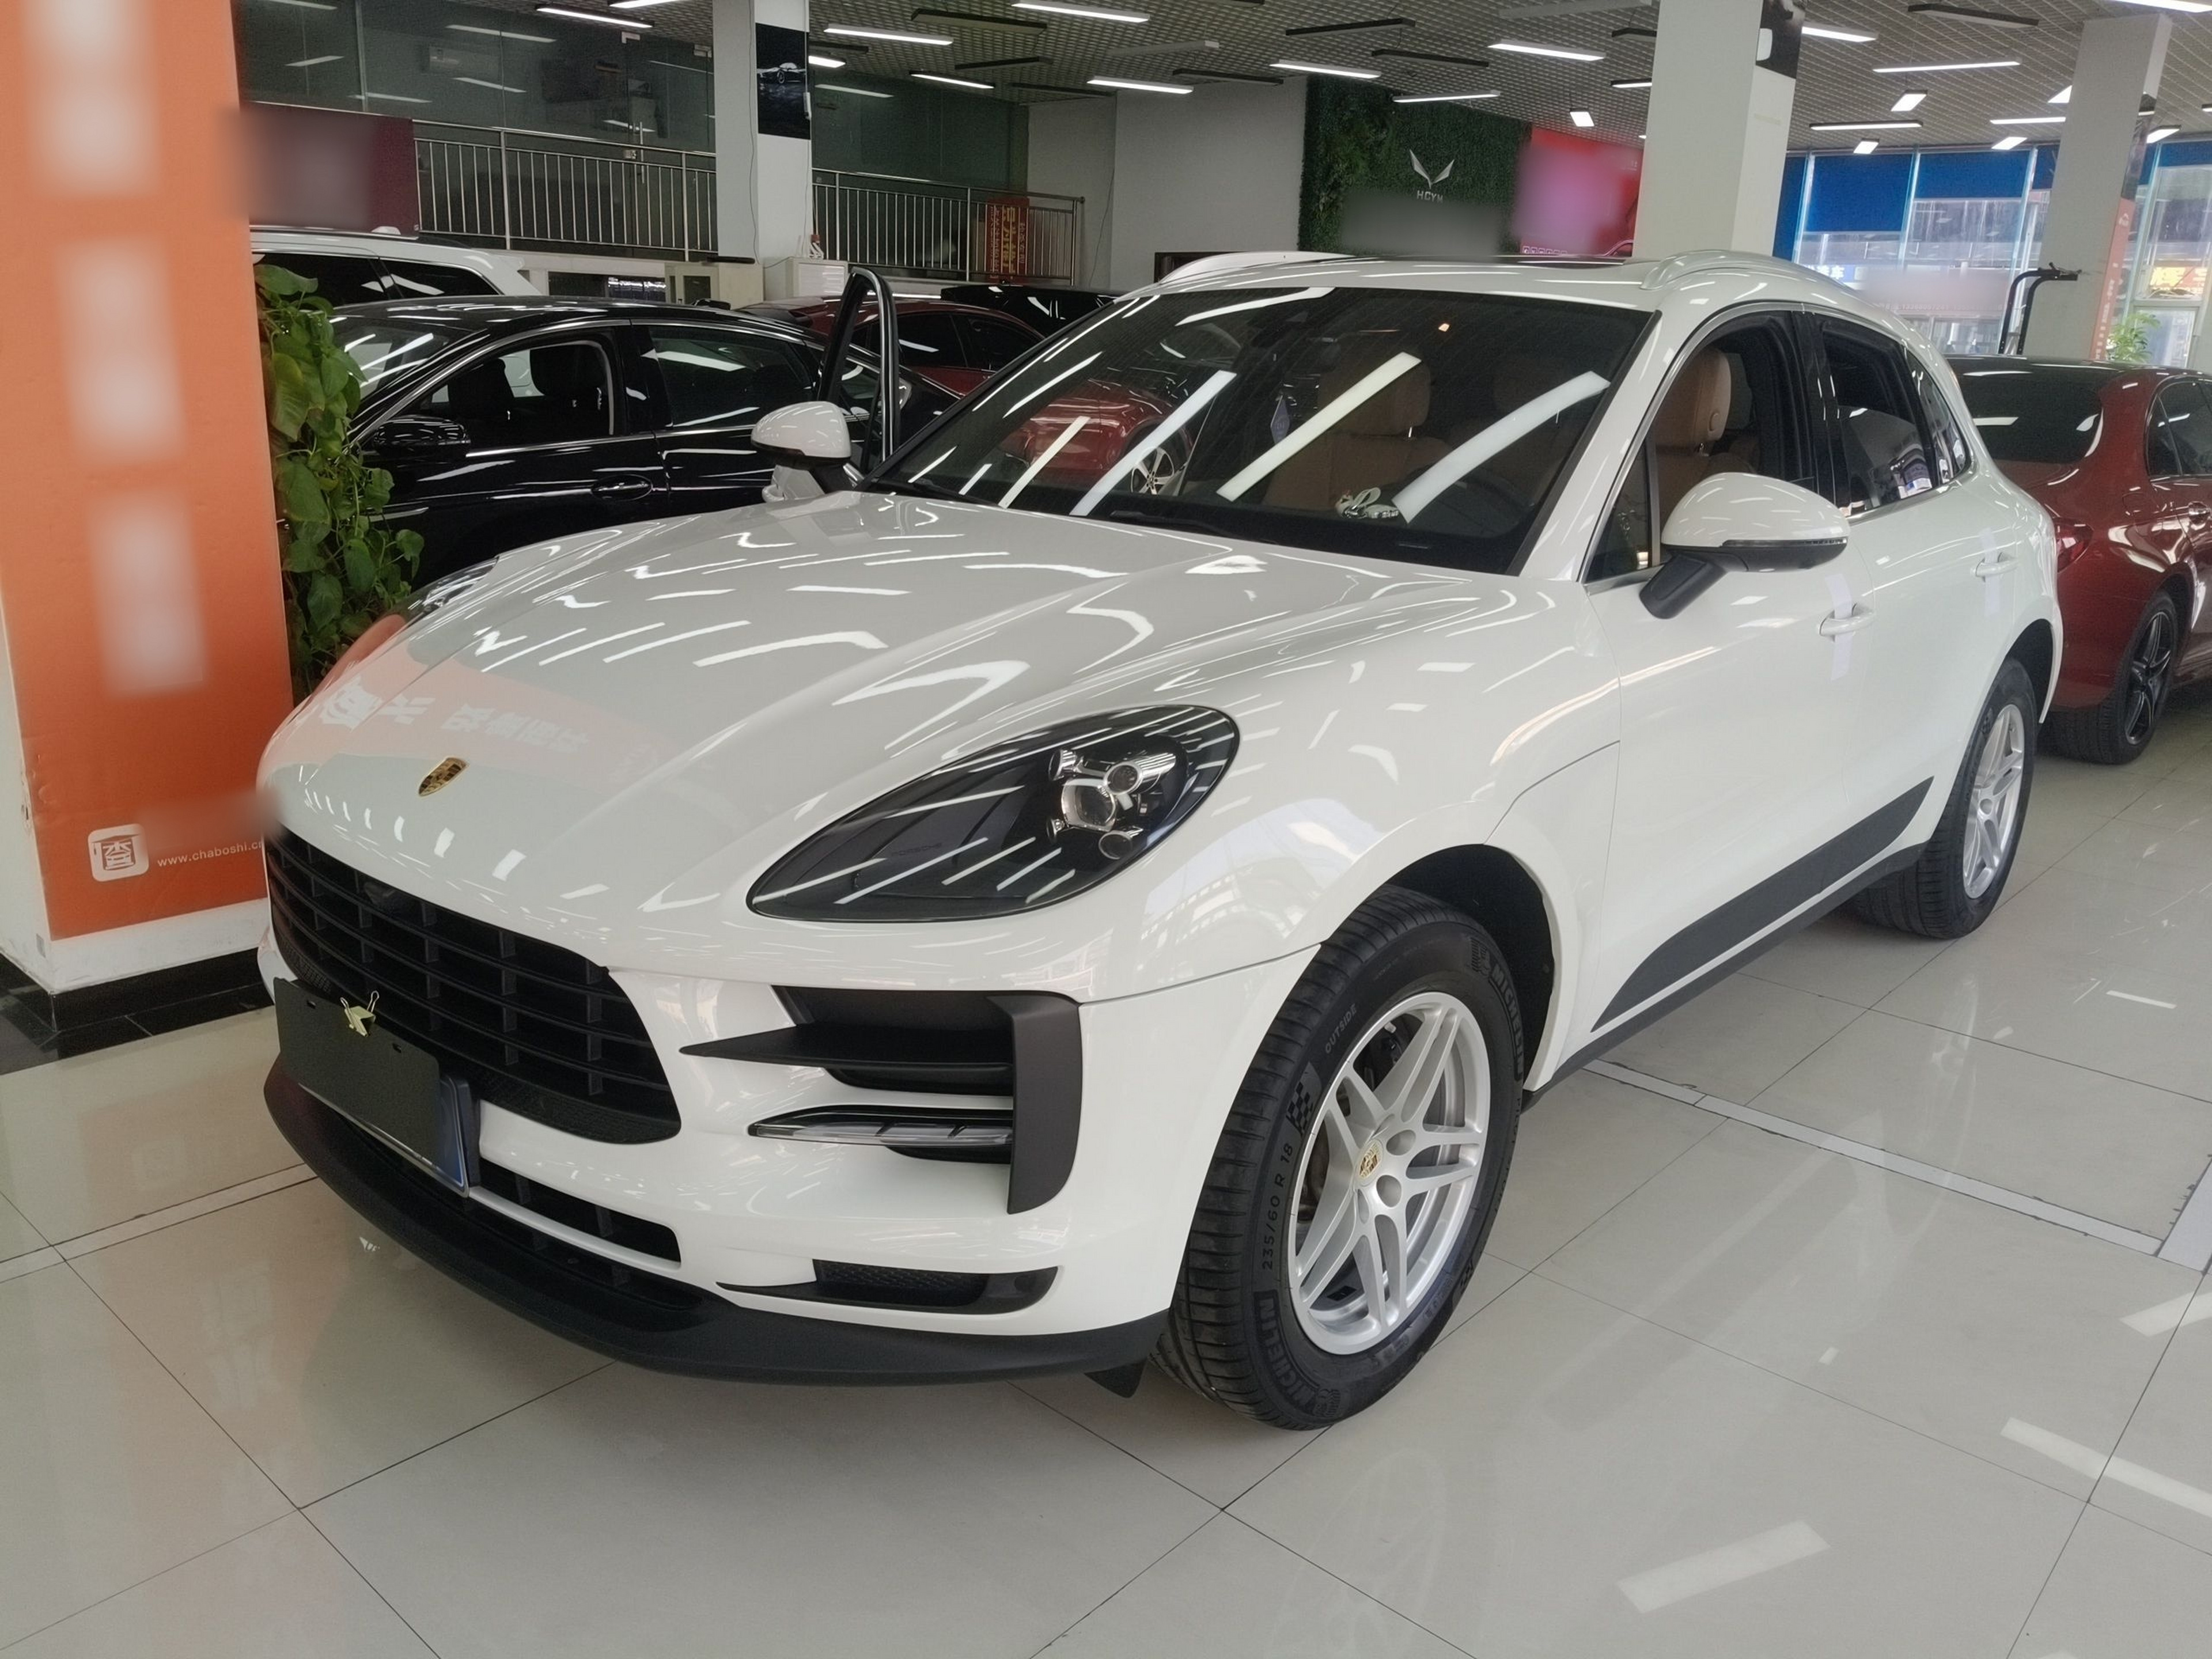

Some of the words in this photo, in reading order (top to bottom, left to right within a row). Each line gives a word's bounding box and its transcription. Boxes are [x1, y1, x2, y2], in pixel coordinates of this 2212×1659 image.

[1325, 1003, 1357, 1054] OUTSIDE
[1491, 964, 1524, 1076] MICHELIN
[1262, 1195, 1281, 1270] 235/60
[1275, 1173, 1286, 1188] R
[1281, 1142, 1293, 1164] 18
[1258, 1297, 1316, 1409] MICHELIN
